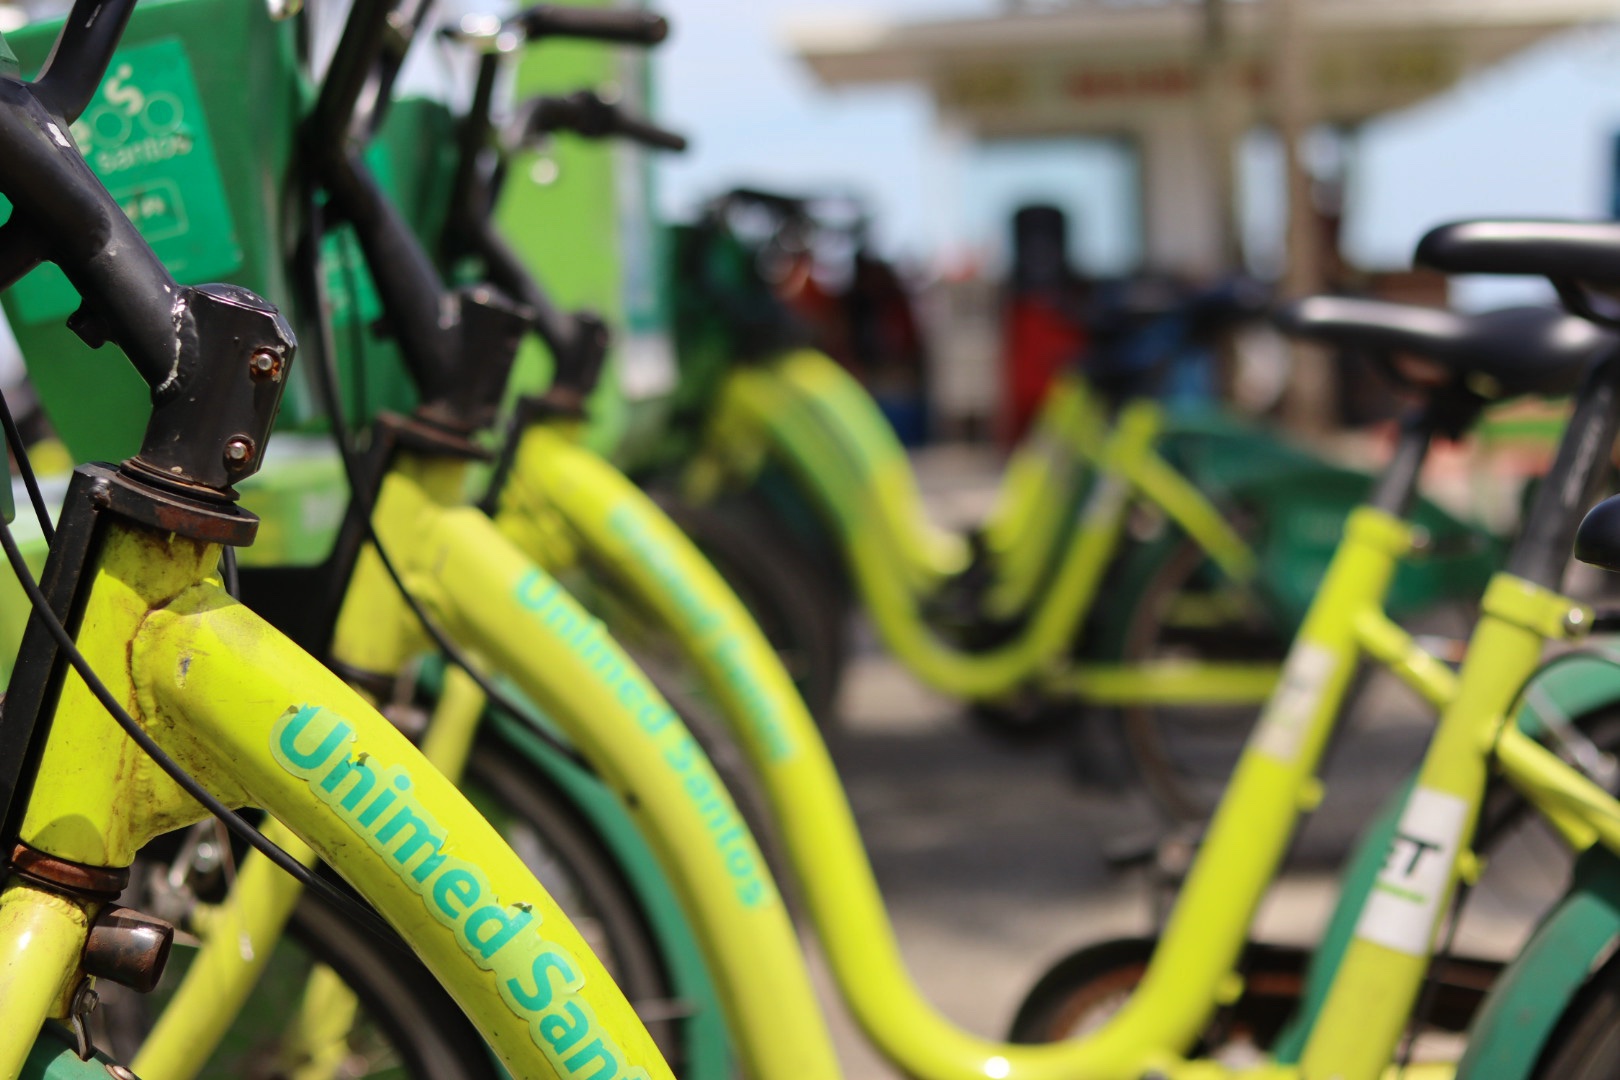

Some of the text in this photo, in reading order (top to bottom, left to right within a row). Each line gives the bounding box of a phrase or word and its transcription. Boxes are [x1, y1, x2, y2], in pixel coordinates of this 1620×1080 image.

[278, 702, 642, 1080] Unimed San
[516, 568, 678, 735] Unimed
[663, 738, 764, 907] Santos
